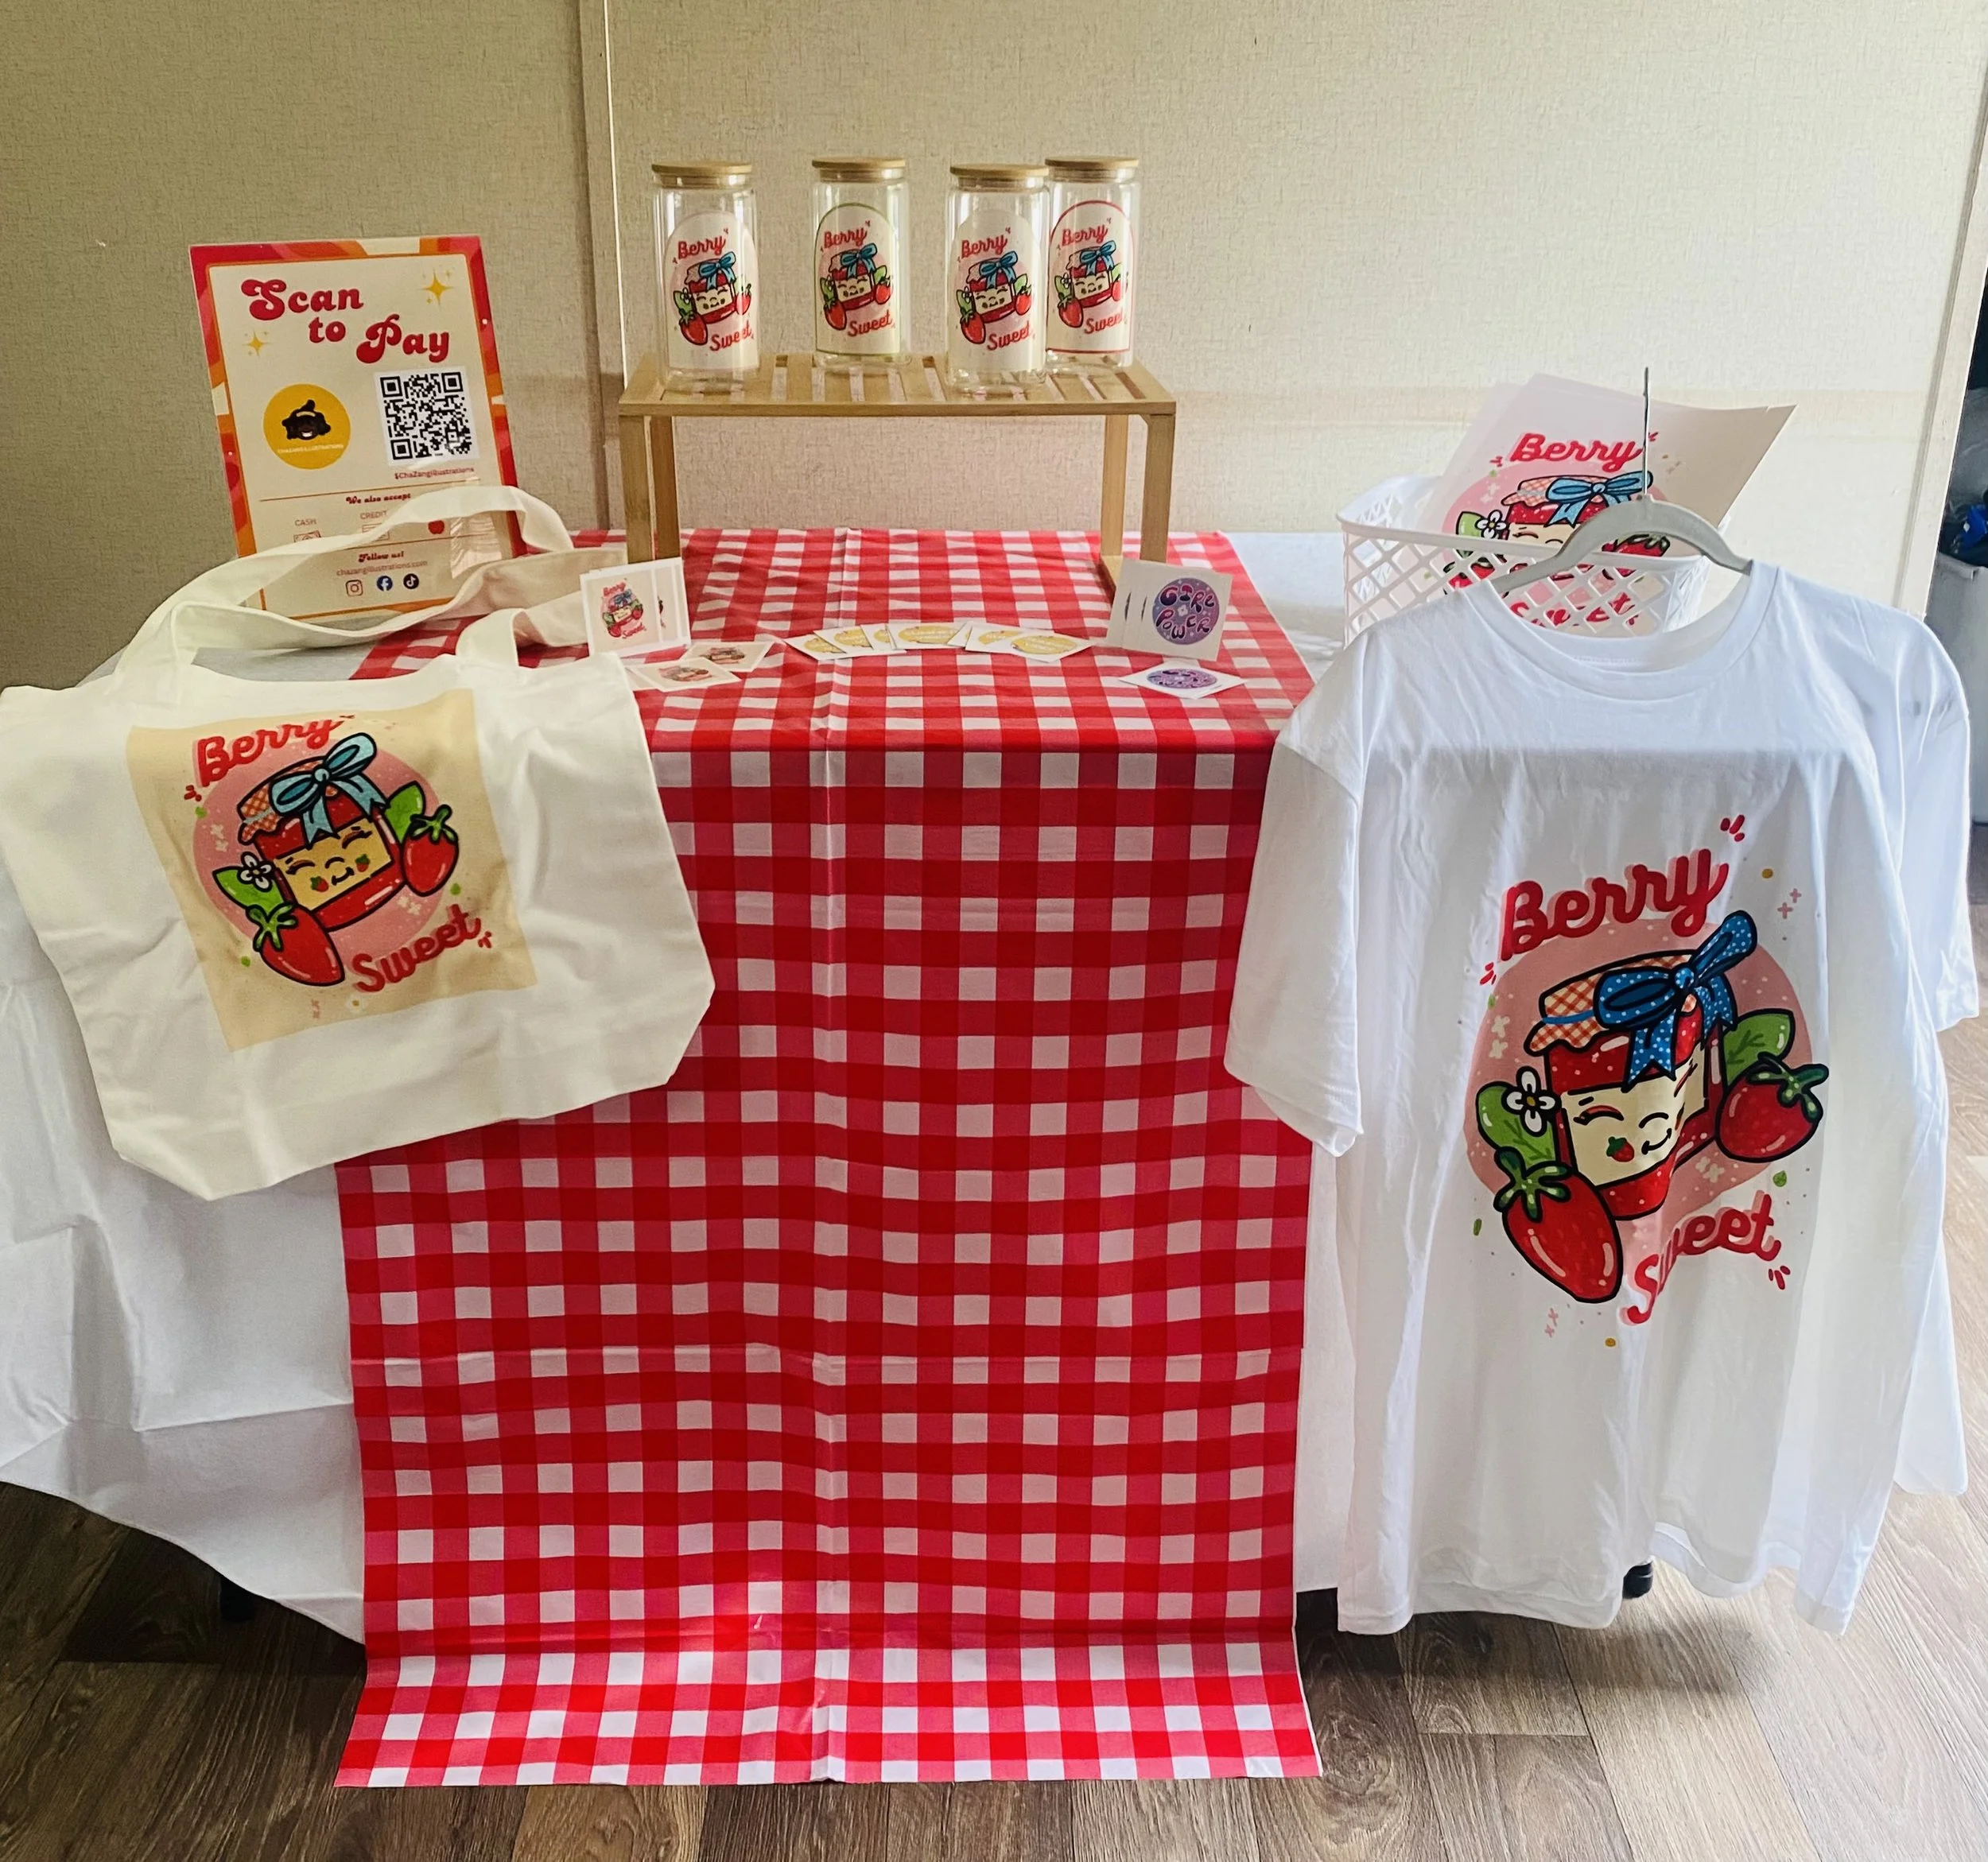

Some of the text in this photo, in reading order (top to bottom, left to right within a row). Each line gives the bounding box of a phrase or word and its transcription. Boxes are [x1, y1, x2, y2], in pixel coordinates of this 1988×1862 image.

[678, 235, 726, 260] Berry
[824, 227, 868, 249] Berry
[961, 235, 1008, 259] Berry
[1062, 223, 1109, 246] Berry
[241, 279, 364, 320] Scan
[709, 320, 752, 351] Sweet
[847, 309, 893, 337] Sweet
[987, 320, 1032, 351] Sweet
[308, 314, 450, 363] to Pay
[1509, 433, 1644, 472] Berry
[346, 492, 411, 504] We also accept
[360, 510, 387, 519] CREDIT
[358, 553, 389, 563] Follow
[1155, 609, 1211, 639] POWER
[193, 719, 345, 788] Berry
[1500, 848, 1730, 961] Berry
[353, 903, 482, 993] Sweet
